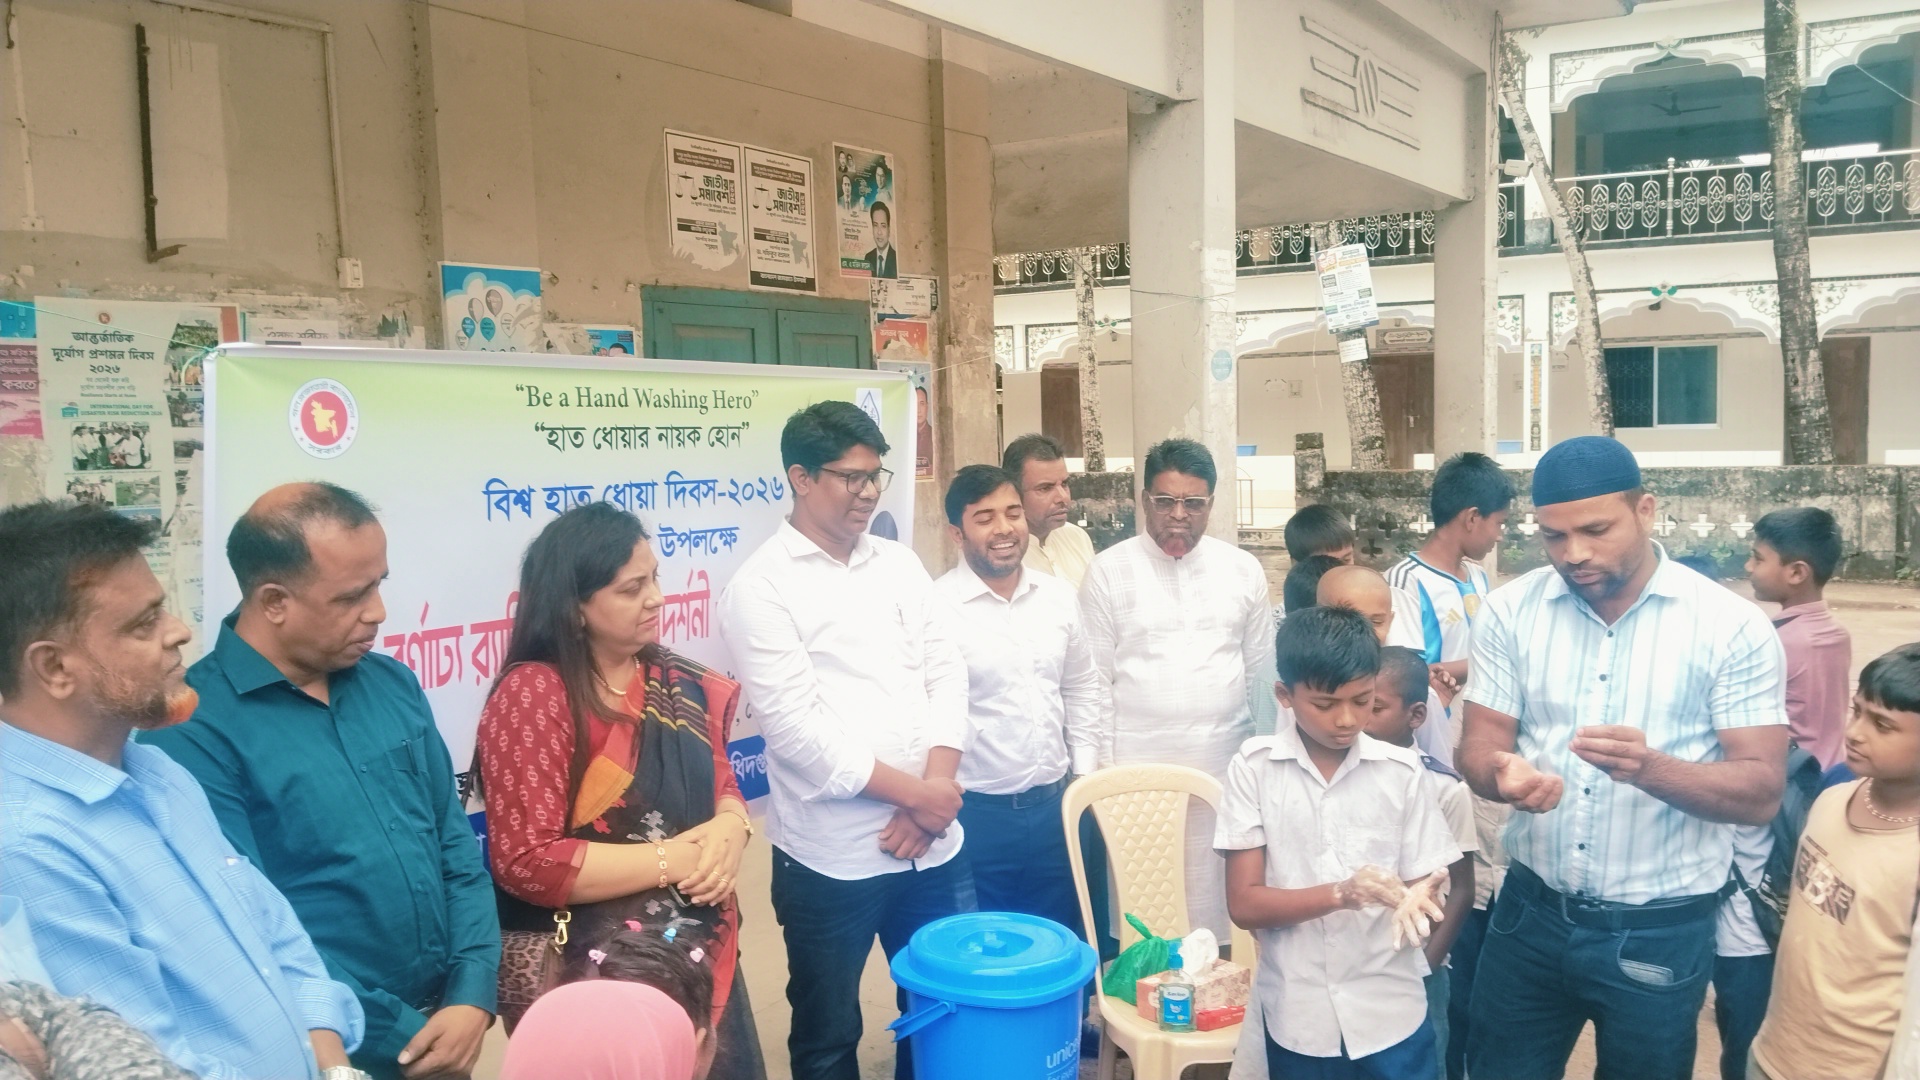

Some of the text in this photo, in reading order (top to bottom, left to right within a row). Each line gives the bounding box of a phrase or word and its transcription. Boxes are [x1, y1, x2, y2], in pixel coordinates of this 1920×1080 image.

[71, 330, 135, 345] আন্তর্জাতিক
[51, 345, 85, 362] দুর্যোগ
[89, 348, 125, 360] প্রশমন
[128, 347, 155, 360] দিবস
[89, 364, 121, 374] ২০২৬
[559, 392, 570, 408] a
[575, 386, 629, 408] Hand
[632, 387, 709, 416] Washing
[593, 424, 651, 450] ধোয়ার
[655, 424, 702, 450] নায়ক
[482, 470, 784, 522] বিশ্ব হাত ধোয়া দিবস-২০২৬
[656, 522, 740, 558] উপলক্ষে
[656, 568, 710, 645] দর্শনী
[729, 750, 767, 782] ধিদপ্ত
[1046, 1038, 1079, 1069] unic
